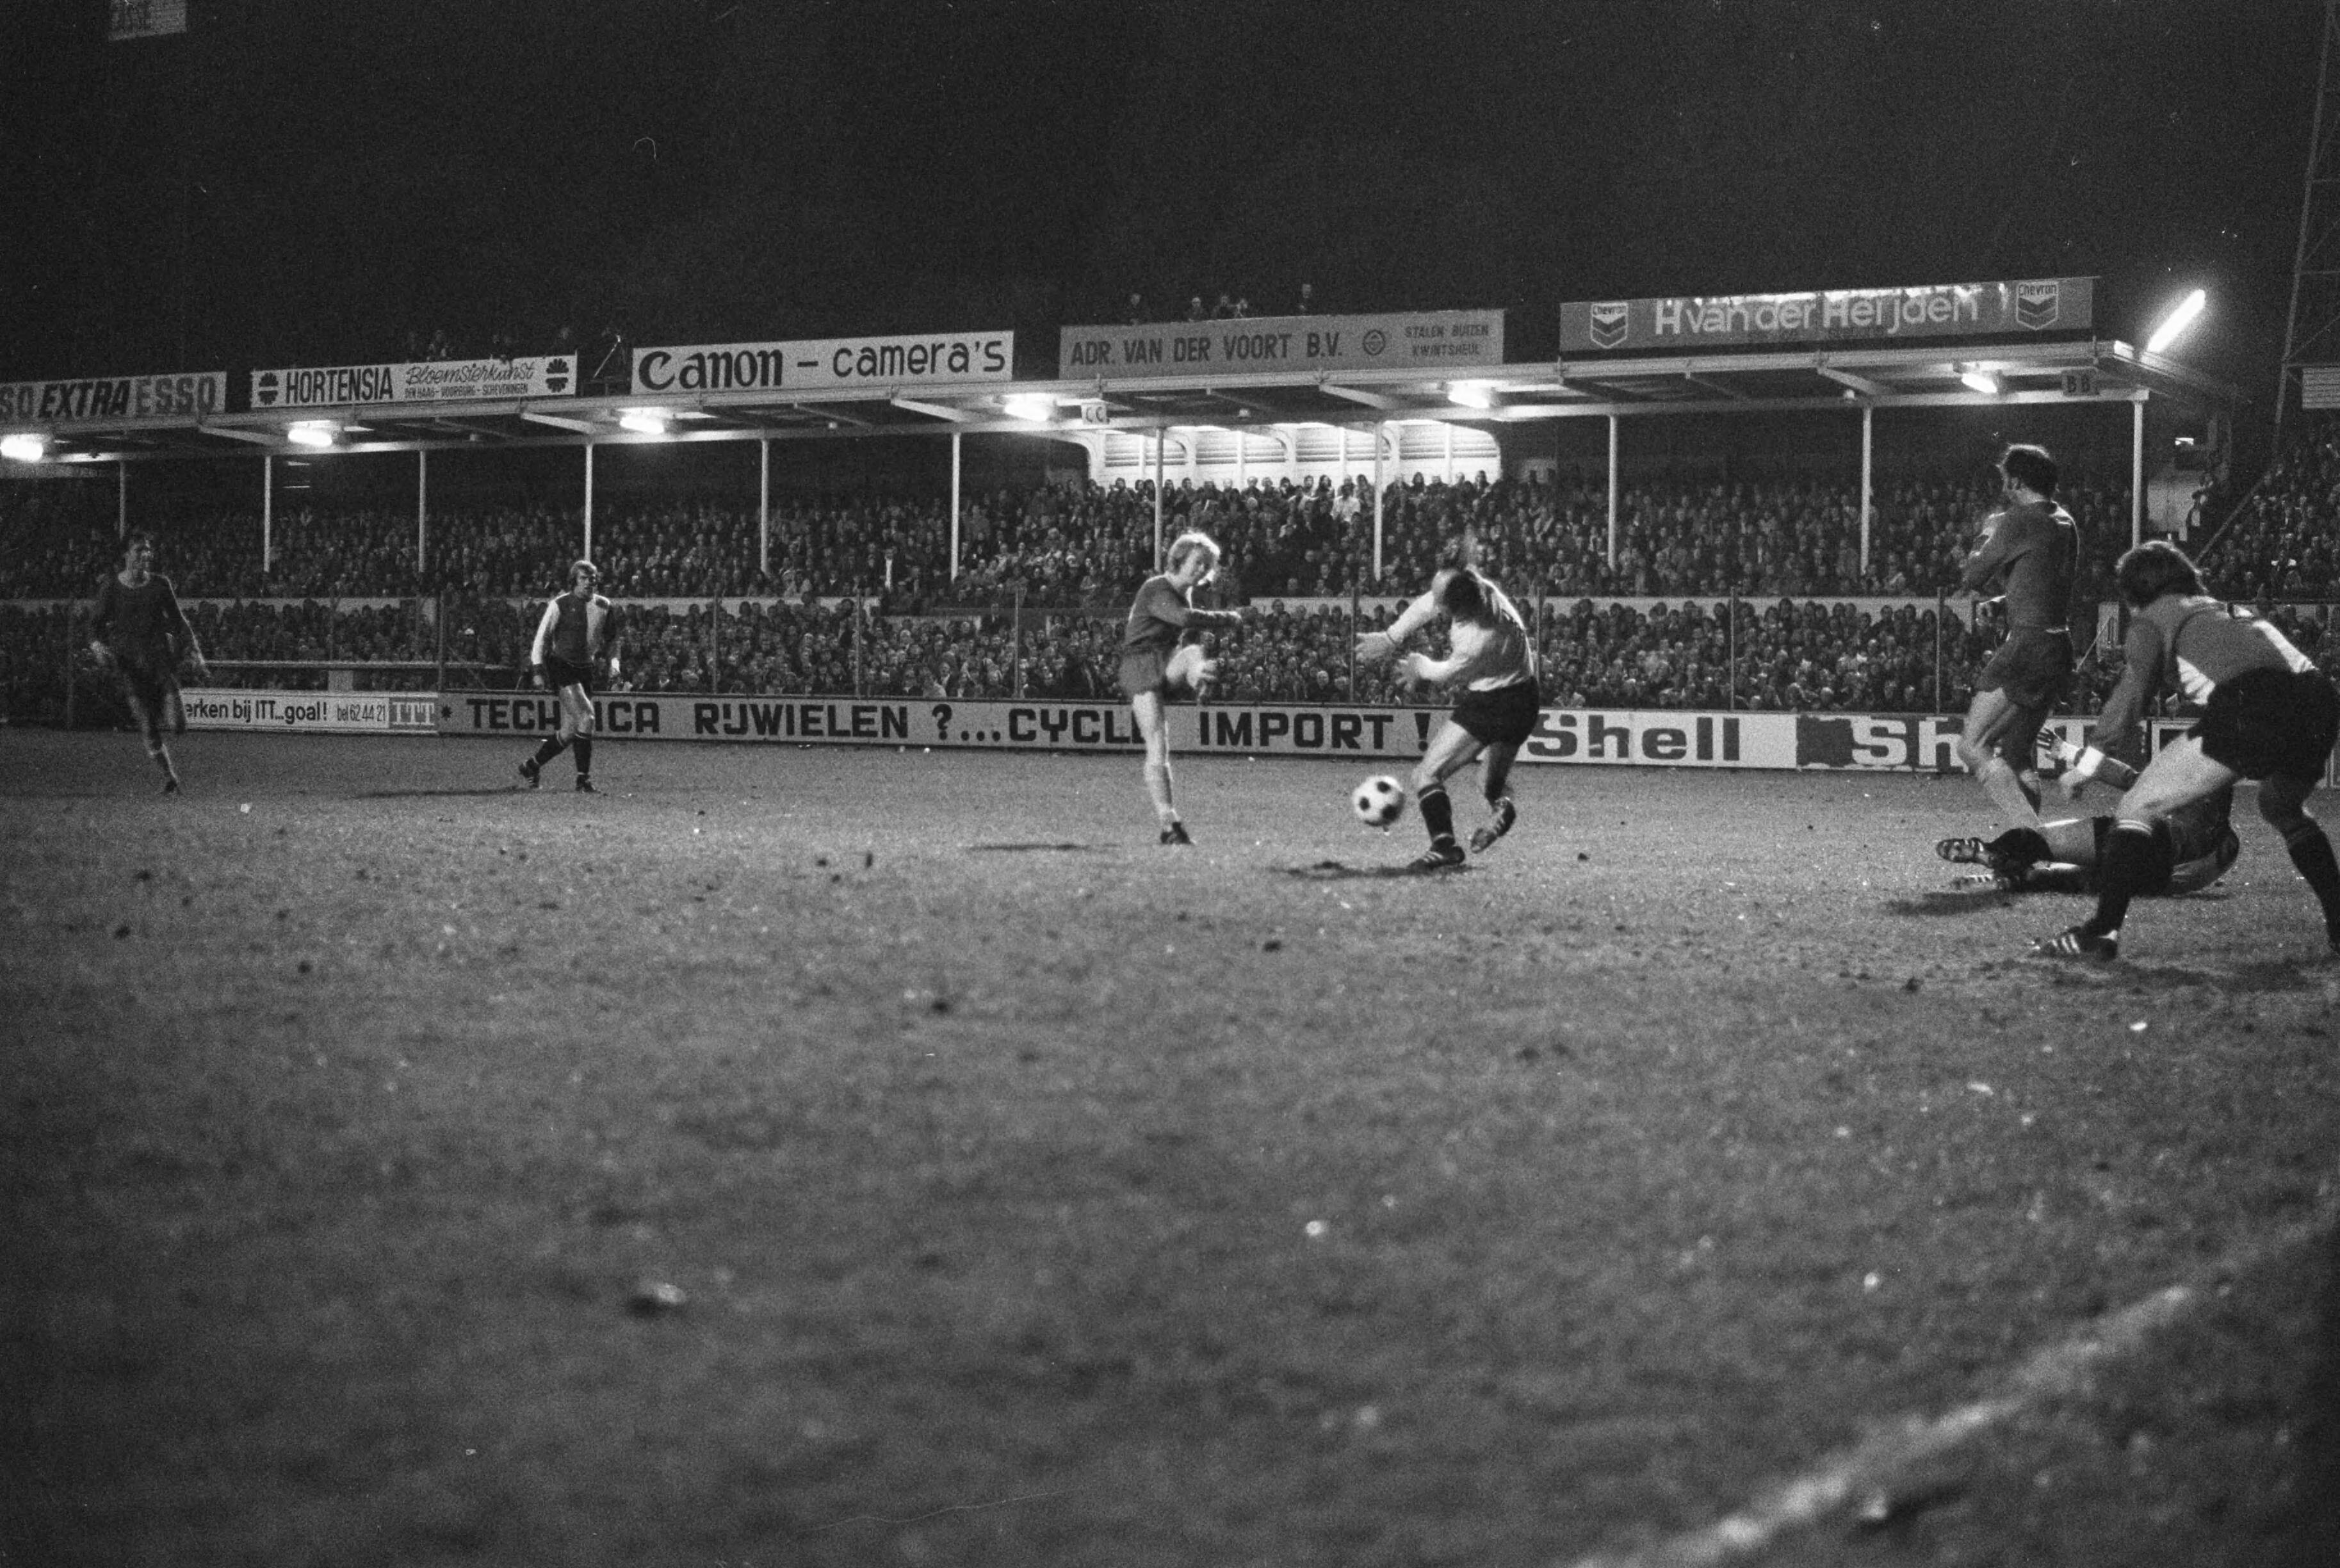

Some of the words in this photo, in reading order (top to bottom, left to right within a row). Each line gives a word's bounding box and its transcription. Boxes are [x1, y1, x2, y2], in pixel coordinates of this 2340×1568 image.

[1655, 299, 1682, 334] H
[1686, 306, 1749, 334] van
[1755, 293, 1817, 330] der
[1823, 289, 1978, 334] Heijden
[639, 348, 783, 390] Canon
[832, 340, 1006, 378] camera's
[1070, 340, 1115, 365] ADR.
[1123, 338, 1162, 363] VAN
[1173, 336, 1211, 362] DER
[1223, 333, 1292, 361] VOORT
[1307, 331, 1342, 358] B.V.
[286, 366, 394, 404] HORTENSIA
[405, 361, 535, 385] Bloemsierkunst
[38, 379, 131, 418] EXTRA
[136, 376, 217, 416] ESSO
[185, 698, 229, 718] erken
[232, 699, 250, 723] bij
[337, 704, 348, 721] bel
[392, 701, 435, 725] ITT
[466, 698, 660, 733] TECHICA
[1199, 711, 1393, 750] IMPORT
[1414, 712, 1431, 752] !
[1527, 713, 1740, 761] Shell
